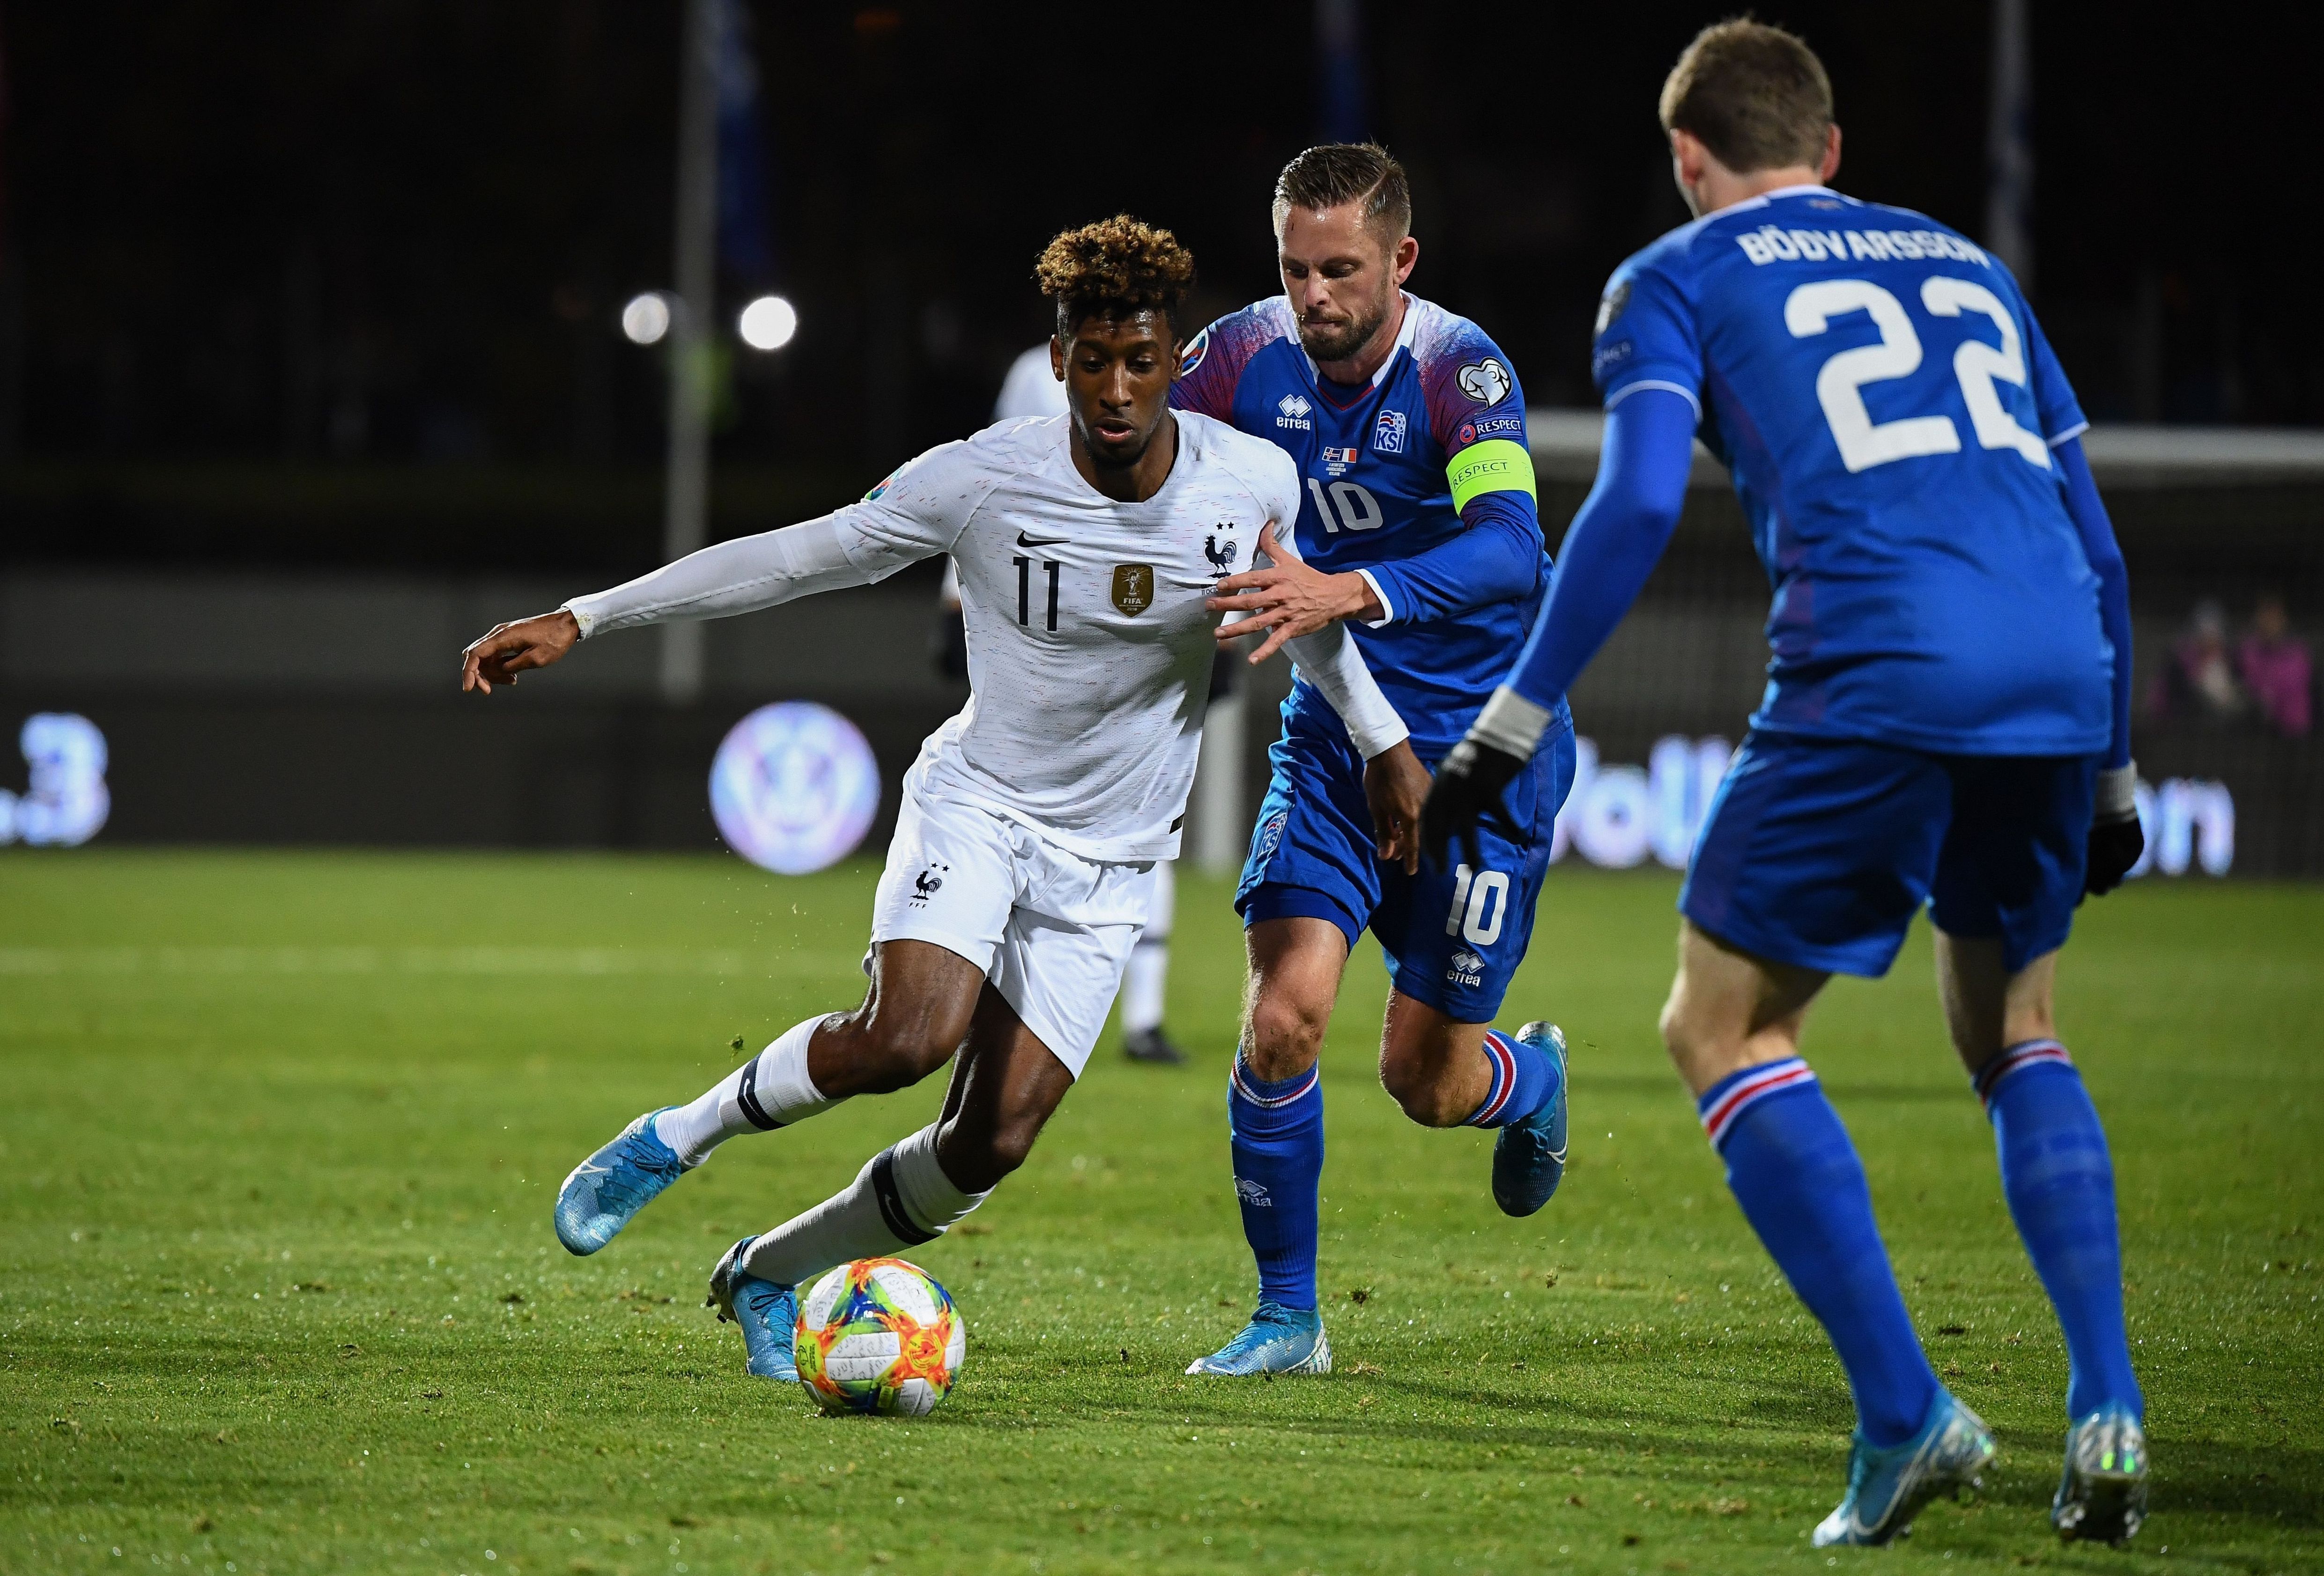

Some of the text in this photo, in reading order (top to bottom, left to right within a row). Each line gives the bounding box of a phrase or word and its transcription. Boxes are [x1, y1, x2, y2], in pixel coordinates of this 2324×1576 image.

[1784, 275, 2052, 474] 22
[1476, 420, 1521, 434] RESPECT
[1308, 478, 1383, 533] 10
[1452, 462, 1508, 489] RESPECT
[1013, 556, 1060, 632] 11
[1446, 864, 1509, 946] 10
